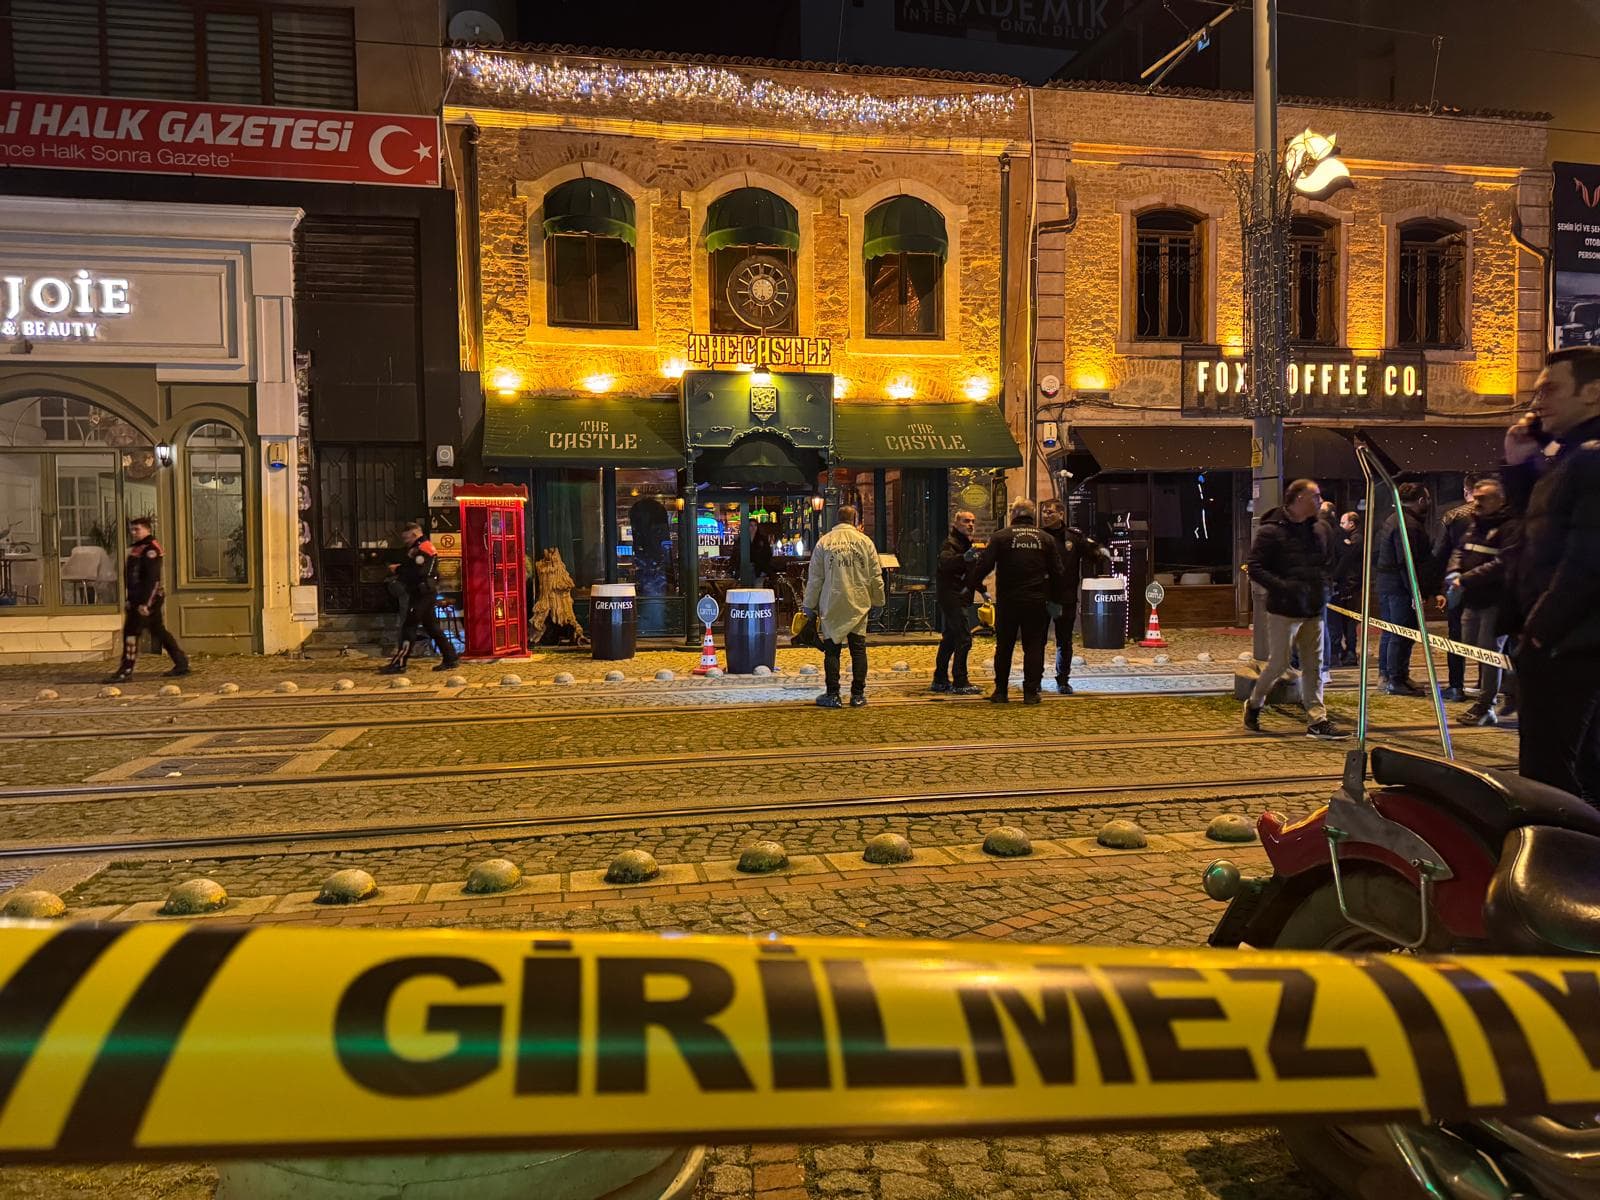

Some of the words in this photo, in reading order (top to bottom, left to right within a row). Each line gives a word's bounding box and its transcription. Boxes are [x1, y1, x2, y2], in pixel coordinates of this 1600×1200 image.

[30, 103, 150, 141] HALK
[158, 110, 354, 152] GAZETESİ
[41, 143, 86, 161] Halk
[92, 146, 152, 164] Sonra
[2, 321, 18, 336] &
[22, 321, 97, 337] BEAUTY
[1197, 361, 1248, 393] FOX
[1286, 363, 1369, 395] OFFEE
[1384, 365, 1423, 396] CO.
[580, 420, 609, 432] THE
[908, 423, 935, 434] THE
[549, 432, 638, 450] CASTLE
[884, 435, 966, 451] CASTLE
[698, 534, 735, 546] CASTLE
[595, 601, 633, 610] GREATNESS
[730, 609, 772, 619] GREATNESS
[333, 938, 1376, 1098] GİRİLMEZ
